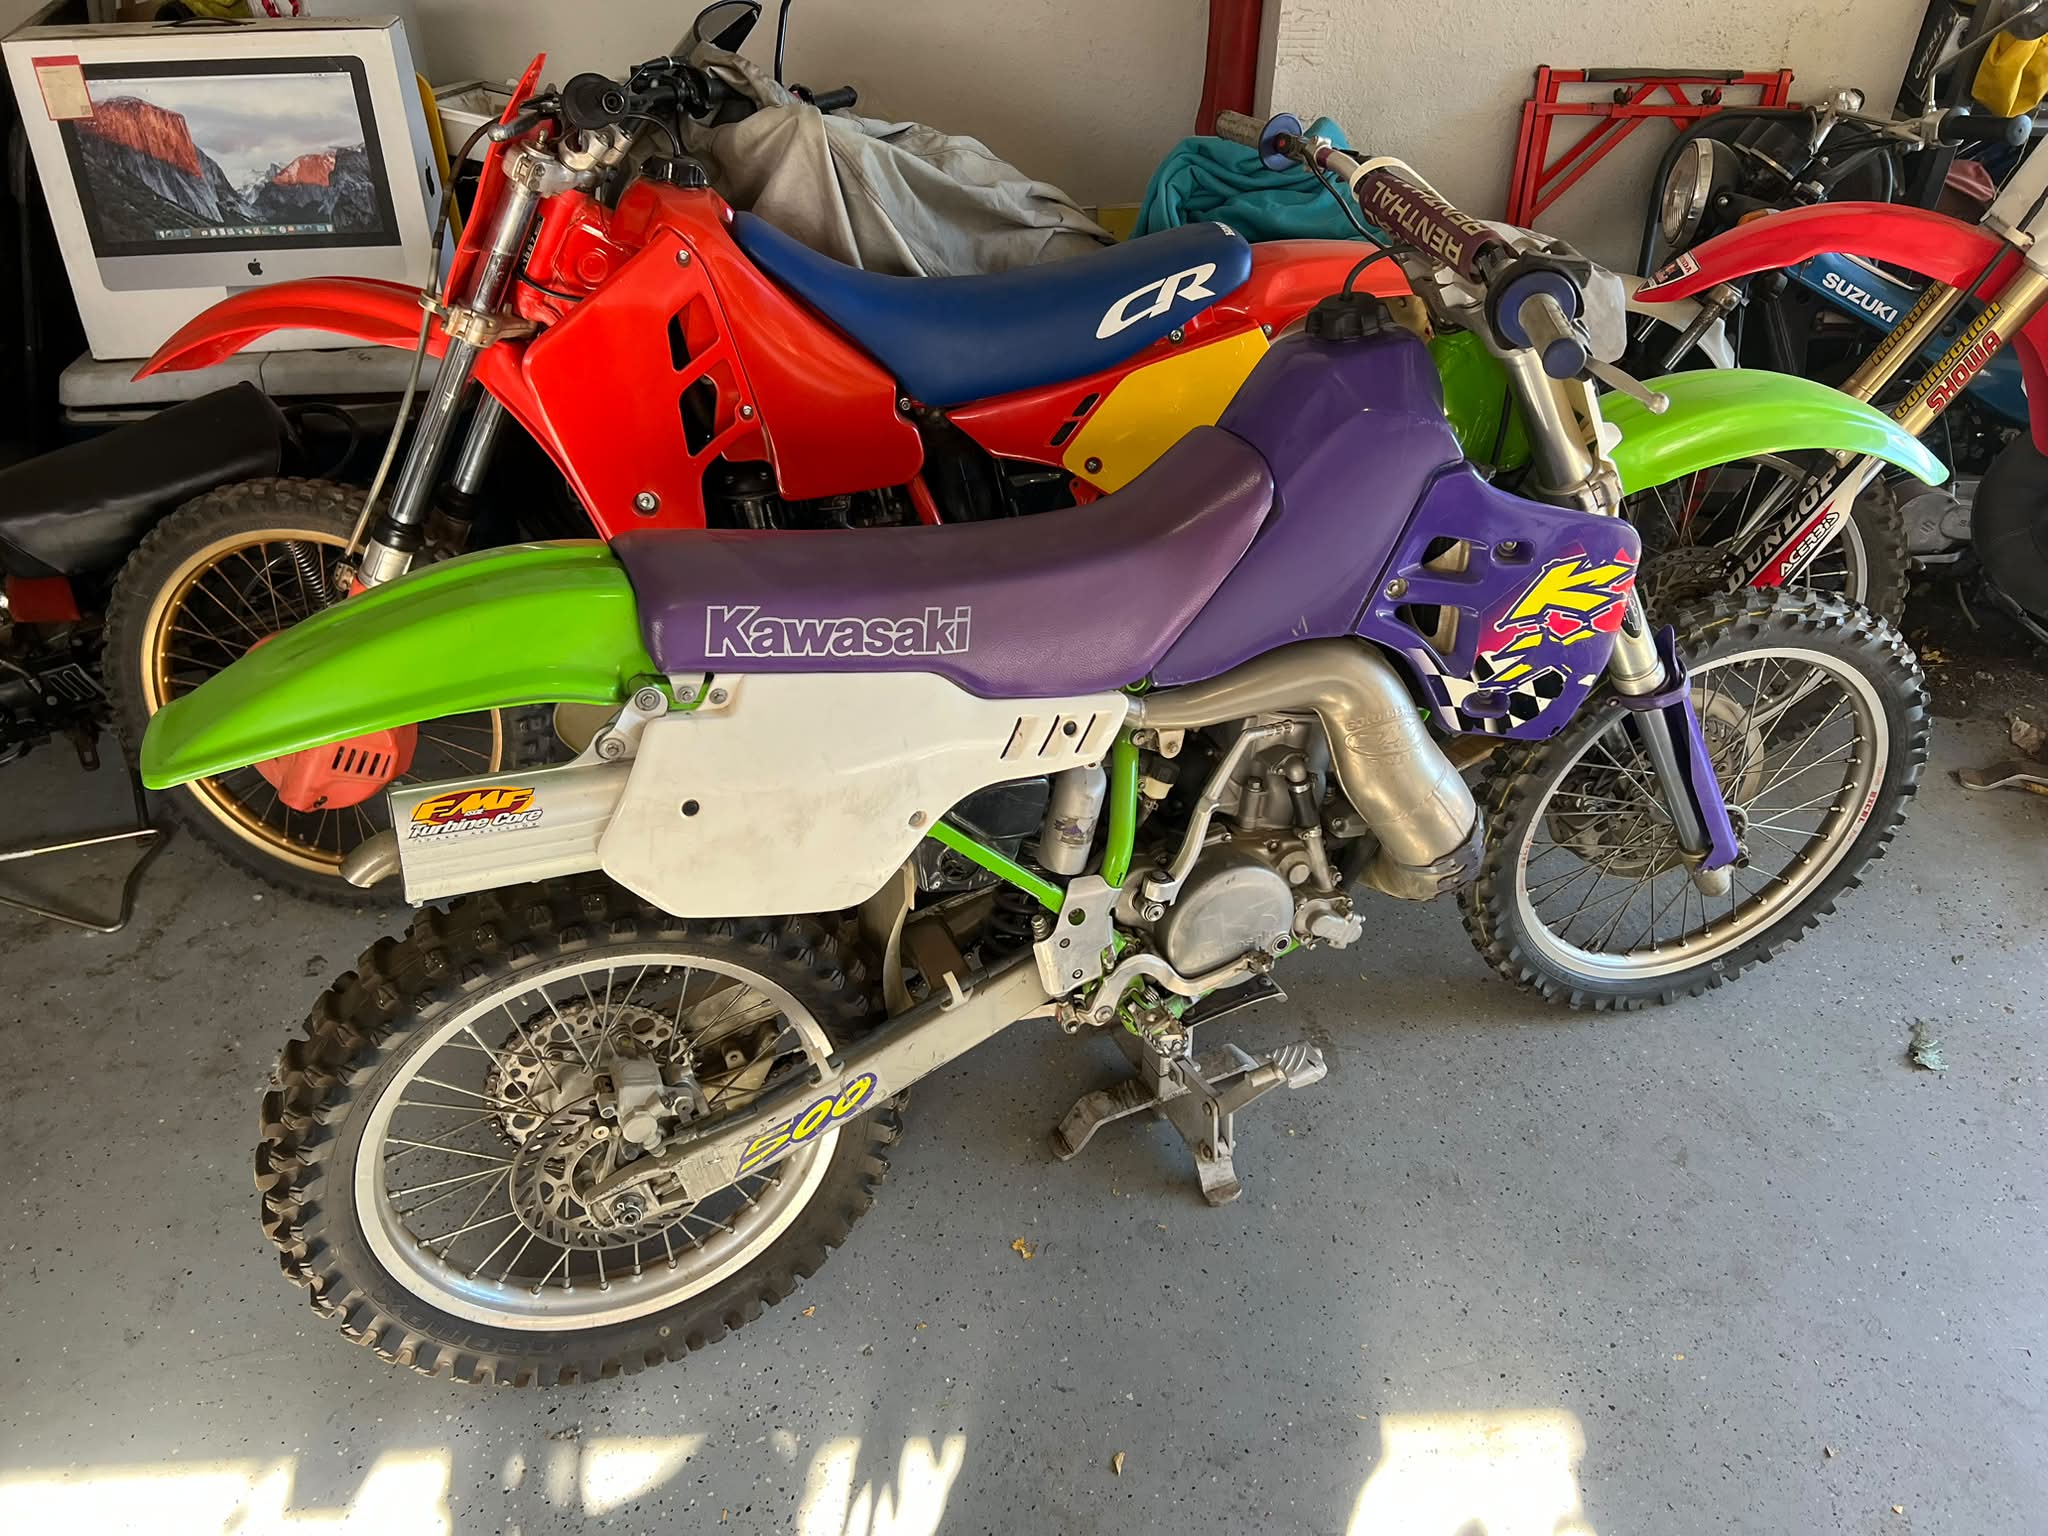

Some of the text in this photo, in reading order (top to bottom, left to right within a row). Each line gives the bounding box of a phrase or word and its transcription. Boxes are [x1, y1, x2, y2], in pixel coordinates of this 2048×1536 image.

[1371, 180, 1464, 266] RENTHAL
[1096, 262, 1217, 339] CR
[1822, 272, 1898, 323] SUZUKI
[1926, 329, 2002, 415] SHOWA
[1727, 464, 1838, 596] DUNLOP
[705, 605, 972, 657] Kawasaki
[408, 817, 490, 840] Turbine
[491, 808, 544, 827] Core
[411, 787, 536, 822] FMF
[1858, 791, 1878, 824] EXCEL
[735, 1072, 878, 1178] 500
